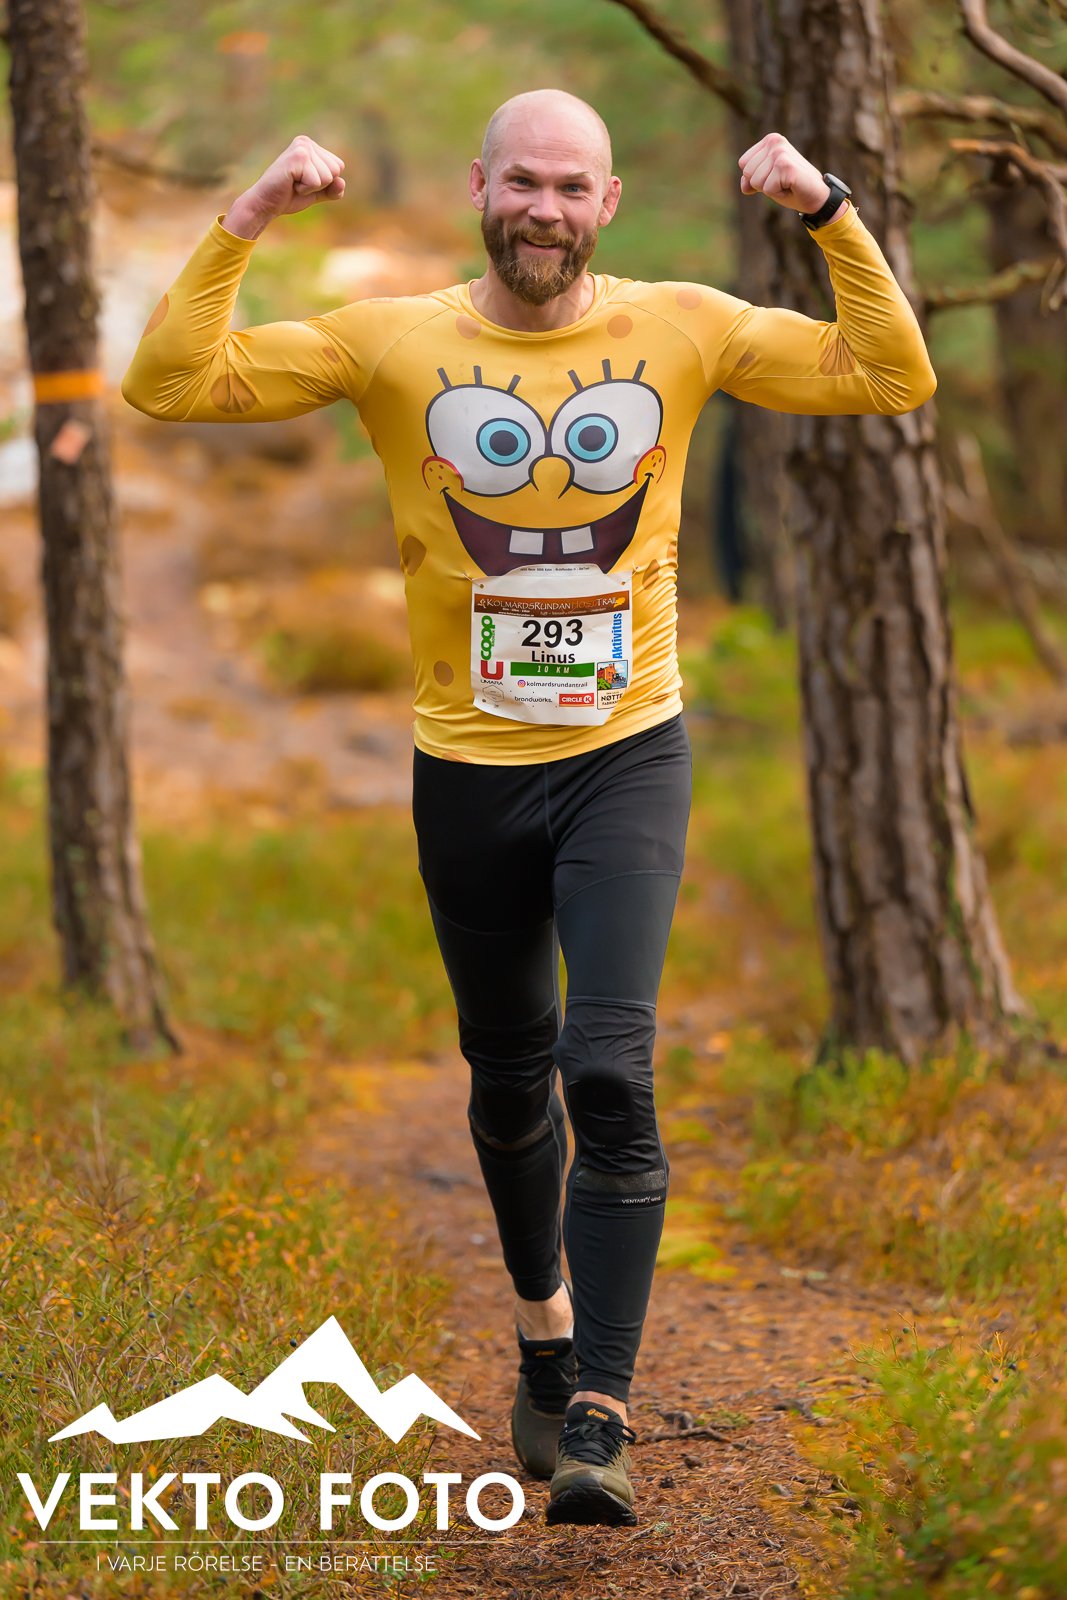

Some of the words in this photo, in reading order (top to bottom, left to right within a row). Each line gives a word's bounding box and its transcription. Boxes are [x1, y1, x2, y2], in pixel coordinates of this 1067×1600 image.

[481, 615, 496, 660] coop
[521, 618, 583, 648] 293
[612, 613, 623, 659] Aktivitus
[531, 651, 576, 664] Linus
[537, 665, 549, 673] 10
[556, 666, 570, 674] KM
